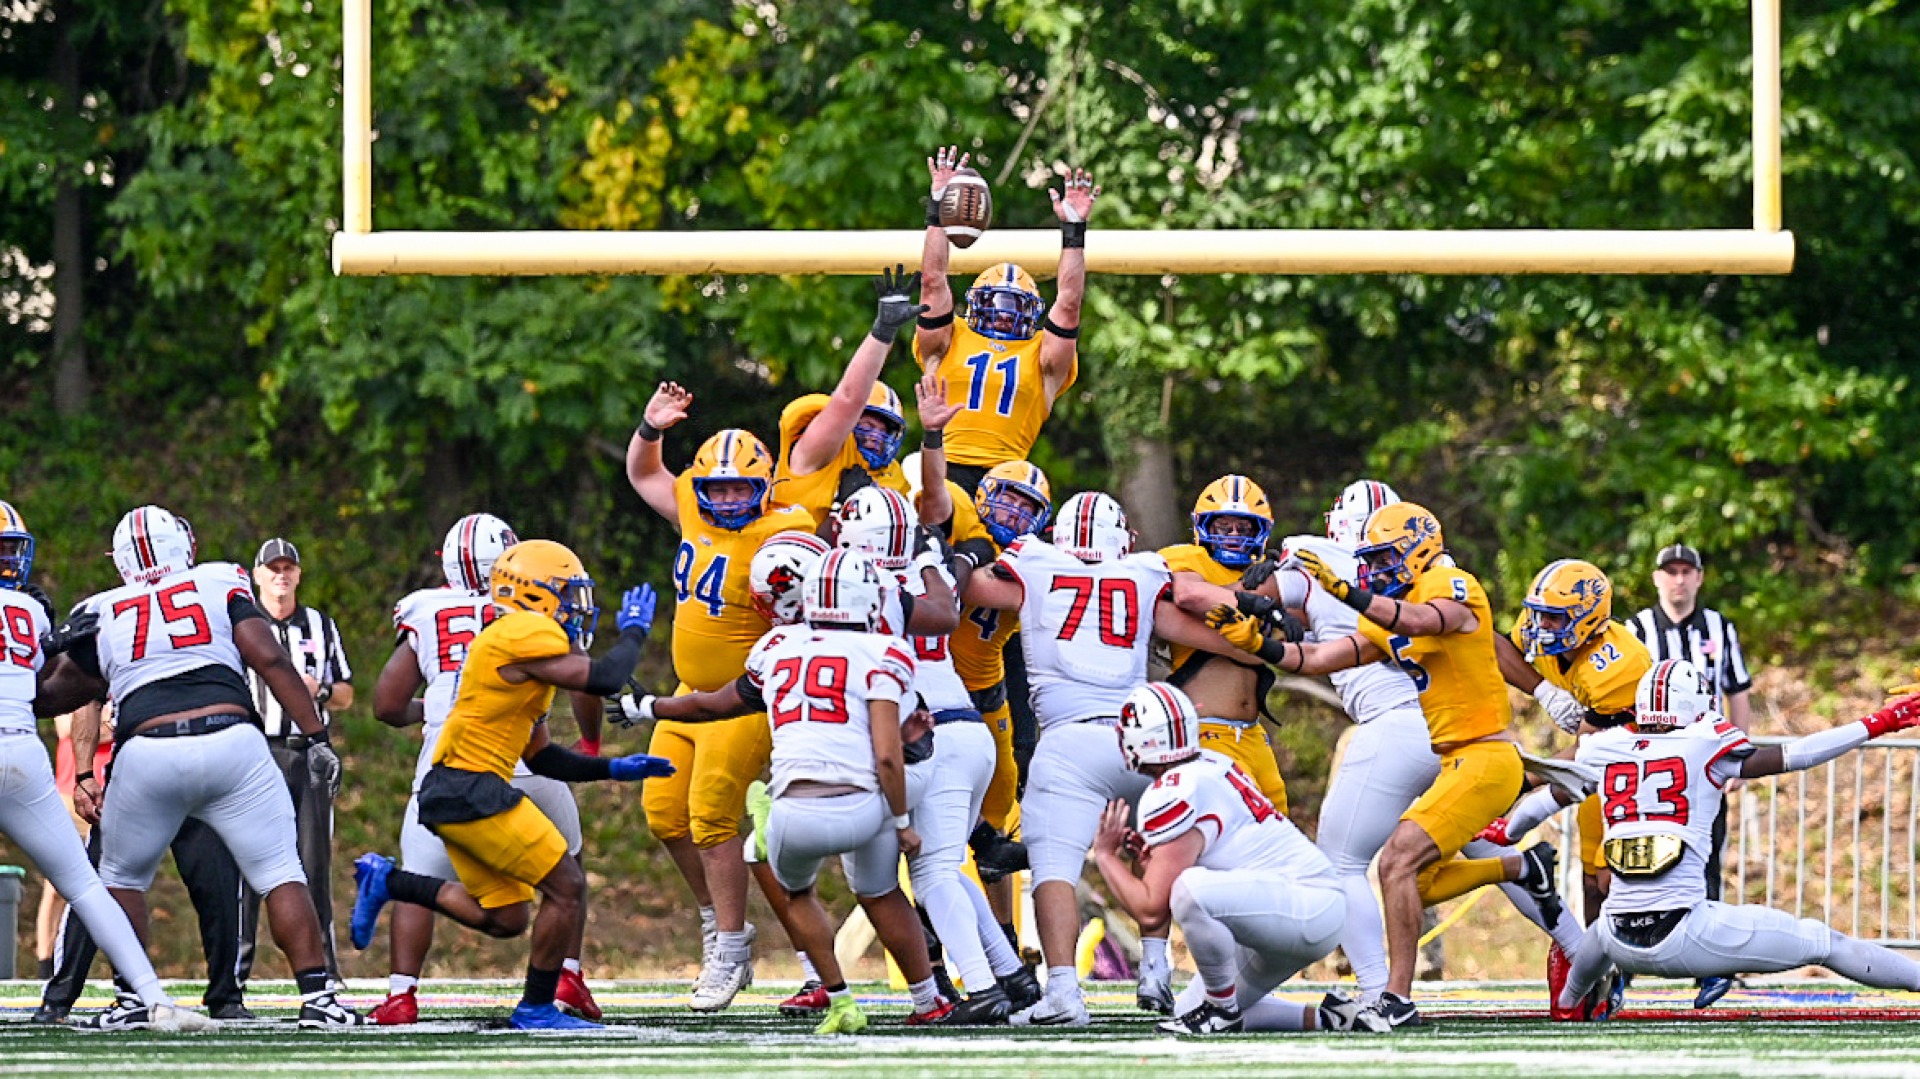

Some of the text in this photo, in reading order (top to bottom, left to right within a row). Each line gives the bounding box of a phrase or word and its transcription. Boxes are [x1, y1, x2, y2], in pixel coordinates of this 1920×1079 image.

[964, 350, 1020, 418] 11
[134, 564, 172, 583] Riddell
[674, 538, 730, 618] 94
[1449, 576, 1468, 603] 5
[112, 580, 212, 663] 75
[435, 603, 496, 673] 6
[810, 611, 850, 621] Riddell
[957, 600, 1000, 643] 4
[1049, 574, 1138, 650] 70
[1387, 634, 1431, 694] 5
[1588, 642, 1624, 673] 32
[771, 655, 850, 731] 29
[1641, 714, 1678, 724] Riddell
[1604, 755, 1690, 830] 83
